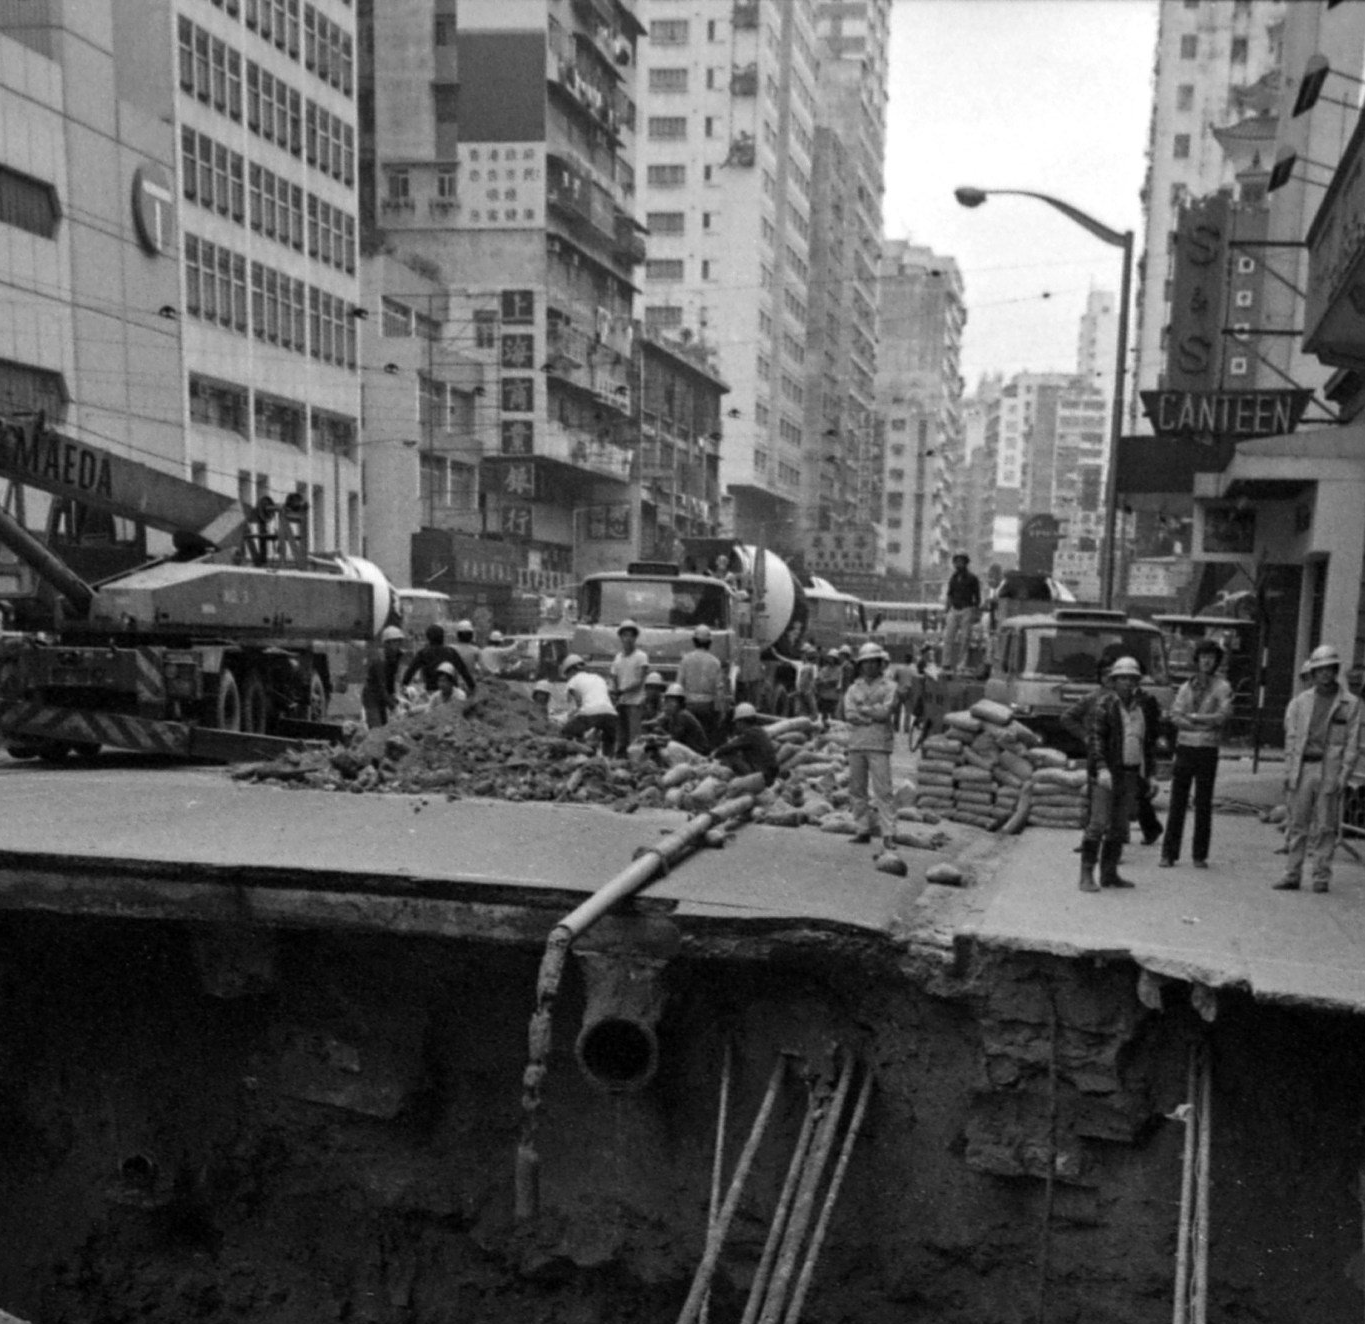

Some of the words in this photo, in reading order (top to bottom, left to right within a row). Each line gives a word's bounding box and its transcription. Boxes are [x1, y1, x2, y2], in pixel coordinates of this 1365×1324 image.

[1187, 225, 1220, 267] S
[1178, 335, 1212, 375] S
[1158, 393, 1291, 434] CANTEEN
[13, 426, 112, 499] MAEDA
